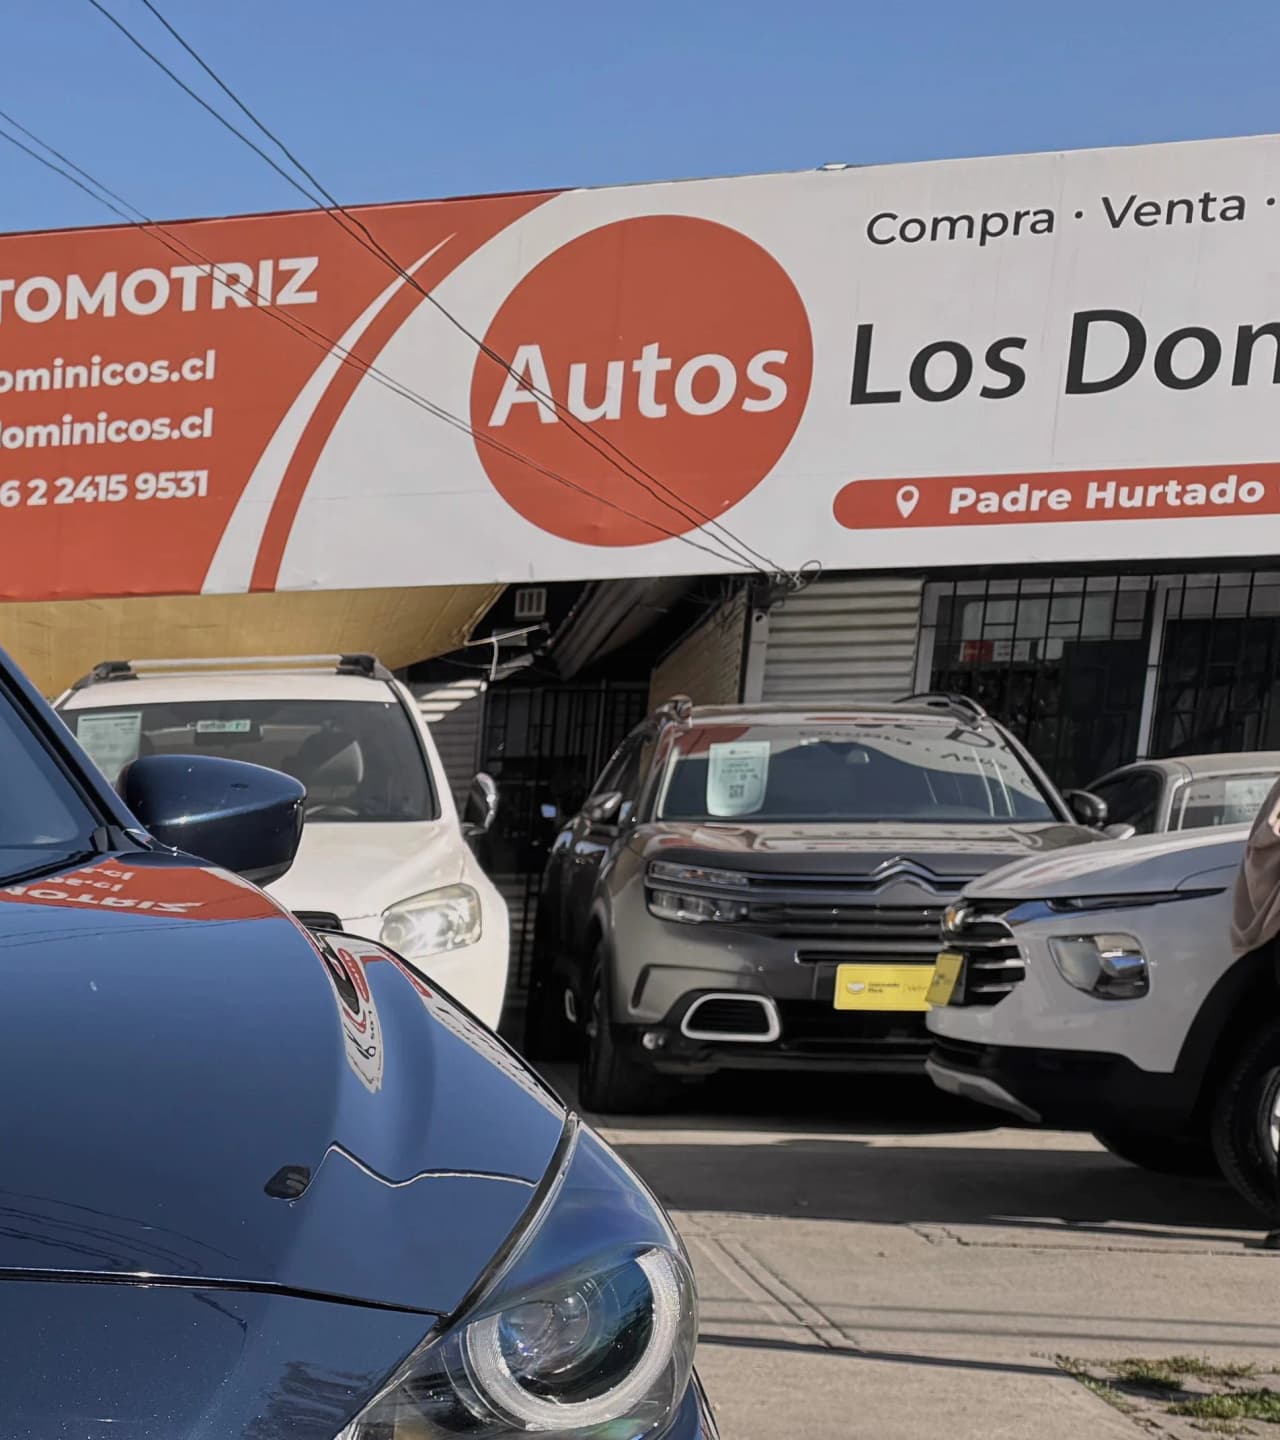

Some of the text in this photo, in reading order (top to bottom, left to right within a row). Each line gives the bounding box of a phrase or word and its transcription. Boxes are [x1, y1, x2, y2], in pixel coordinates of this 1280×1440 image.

[866, 191, 1246, 247] Compra Venta
[487, 342, 790, 428] Autos
[849, 323, 1027, 406] Los
[26, 478, 48, 506] 2
[53, 473, 128, 505] 2415
[134, 469, 209, 501] 9531
[949, 474, 1265, 515] Padre Hurtado
